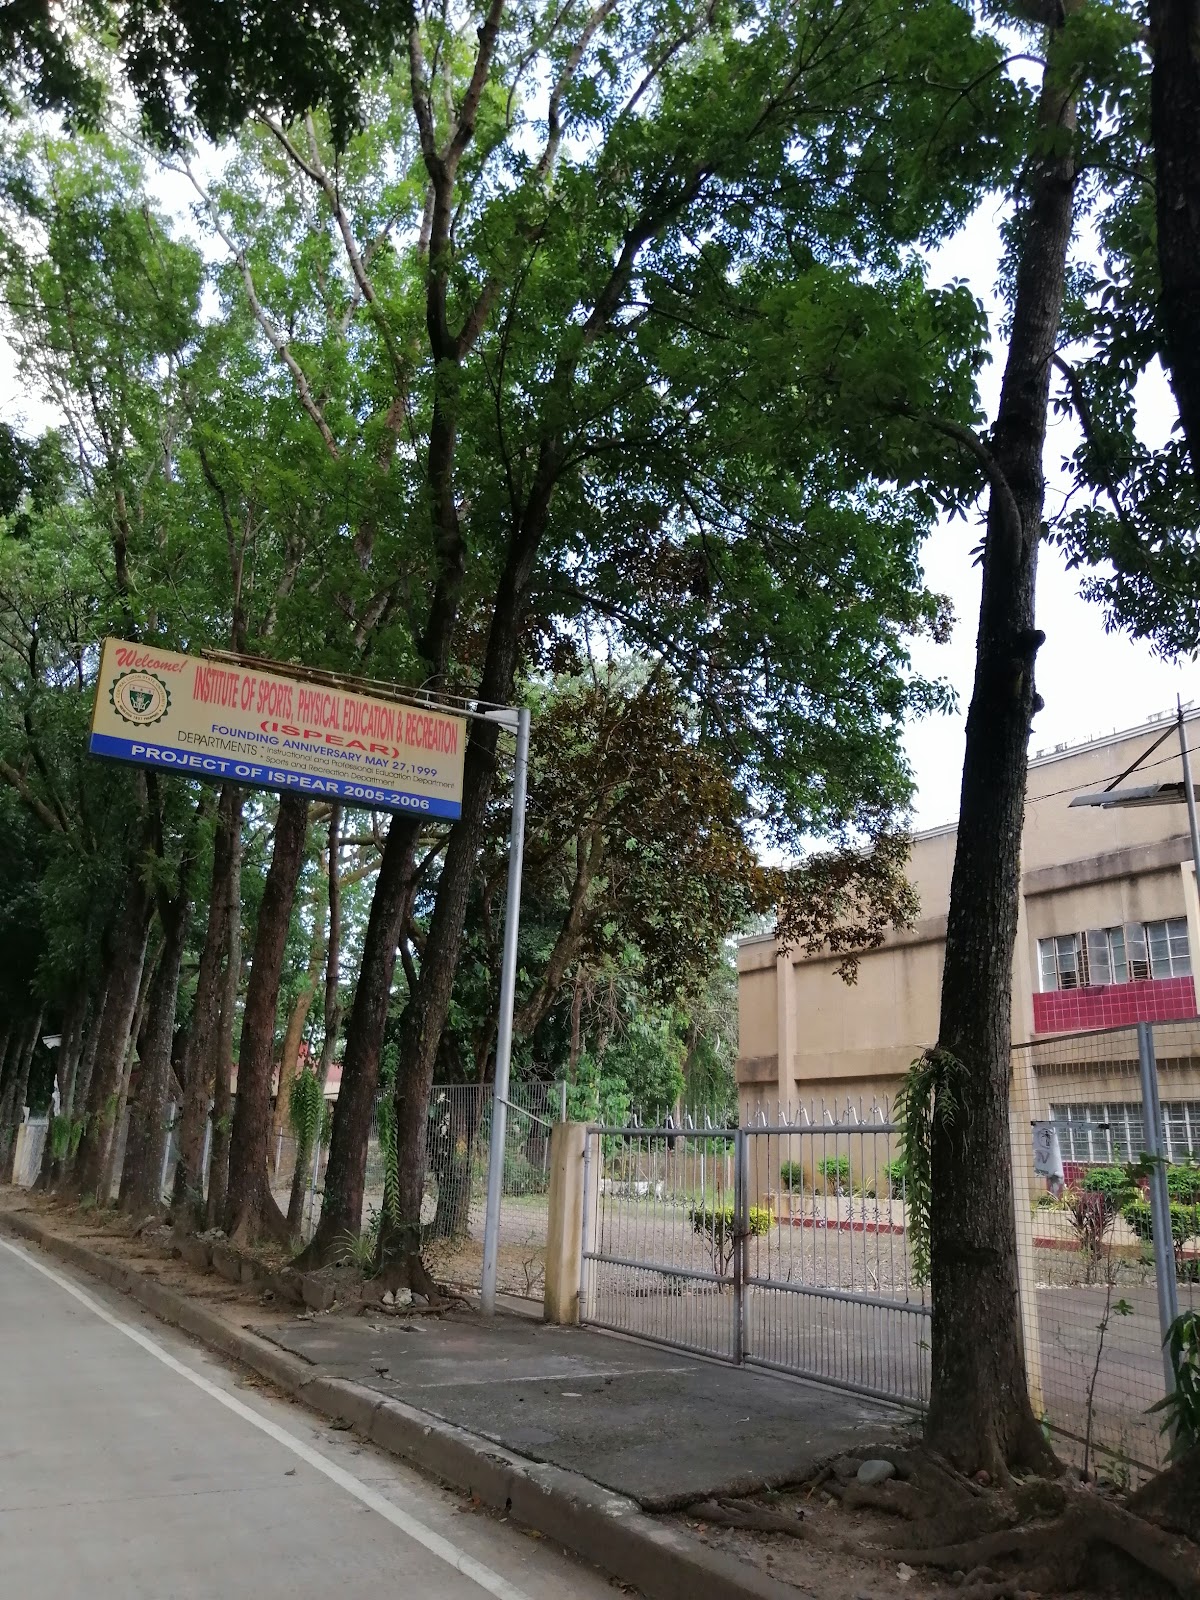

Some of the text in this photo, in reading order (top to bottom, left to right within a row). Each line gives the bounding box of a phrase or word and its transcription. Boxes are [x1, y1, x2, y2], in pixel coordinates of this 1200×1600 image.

[115, 648, 188, 673] Welcome!
[193, 666, 458, 755] INSTITUTE OF SPORTS, PHYSICAL EDUCATION & RECREATION
[177, 730, 257, 756] DEPARTMENTS
[211, 724, 279, 745] FOUNDING
[283, 739, 362, 762] ANNIVERSARY
[365, 756, 389, 767] MAY
[260, 721, 400, 759] (ISPEAR)
[131, 745, 430, 809] PROJECT OF ISPEAR 2005-2006
[266, 756, 395, 787] Sports and Recreation Department
[267, 746, 454, 789] Instructional and Professional Education Department
